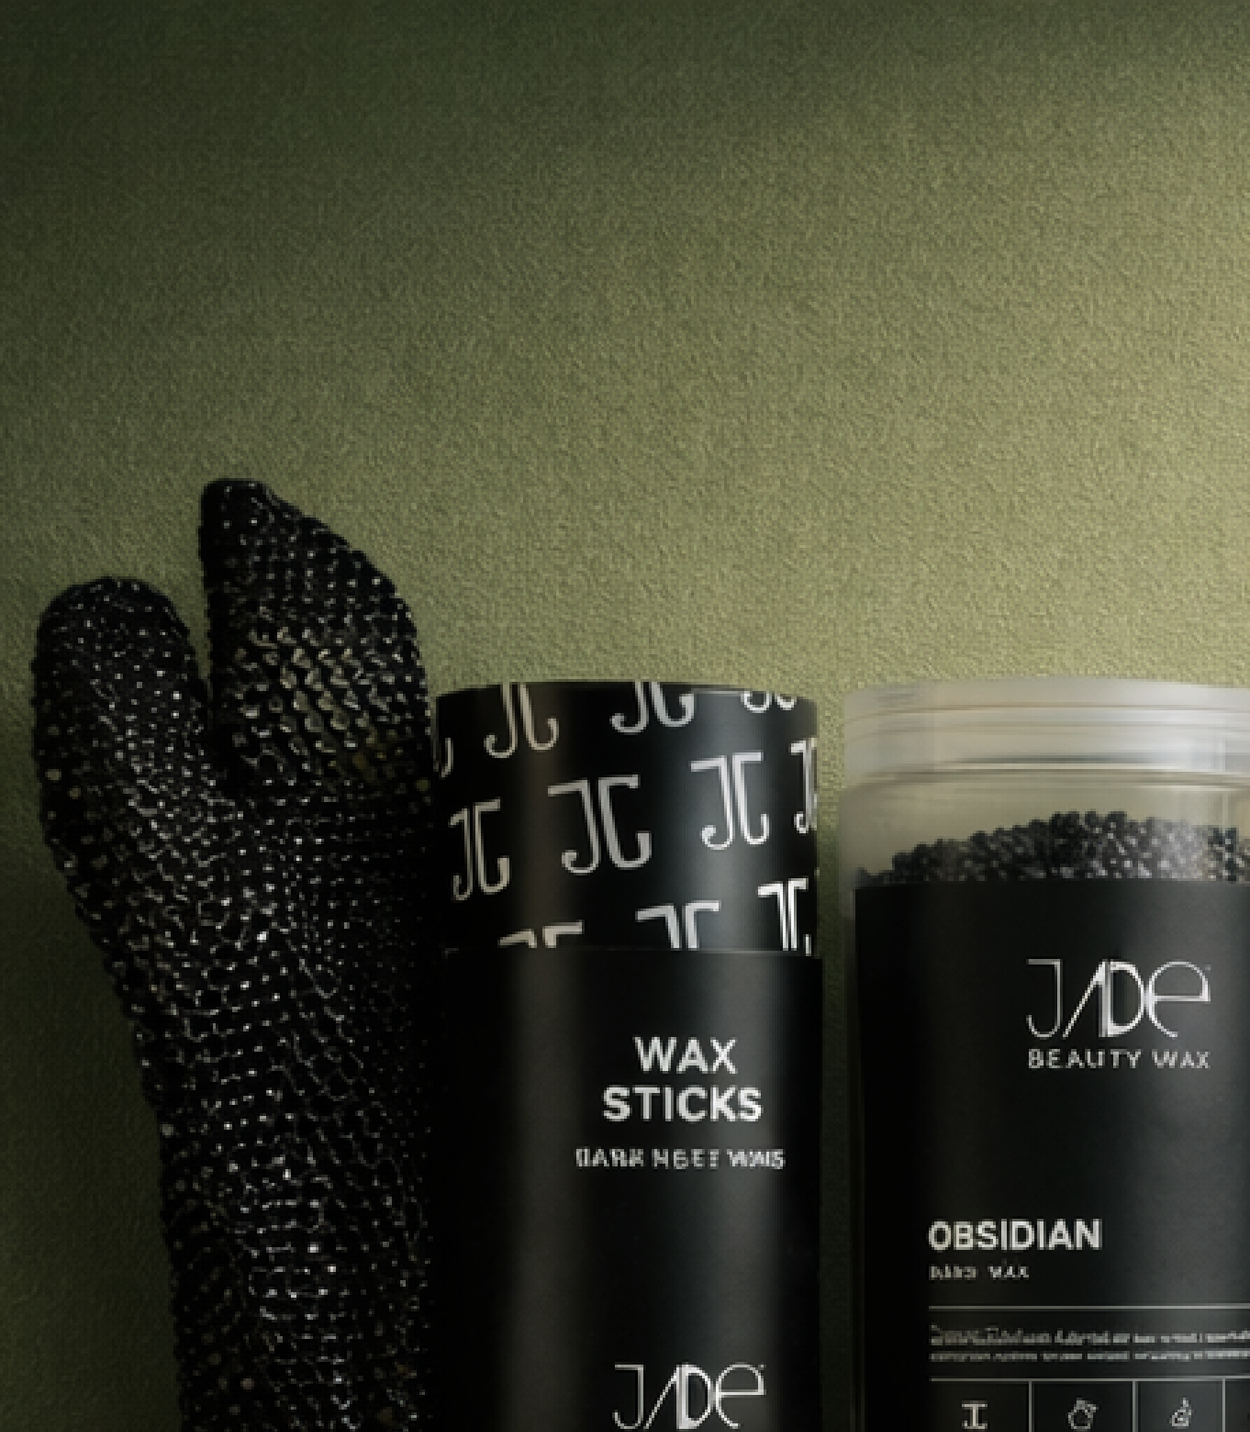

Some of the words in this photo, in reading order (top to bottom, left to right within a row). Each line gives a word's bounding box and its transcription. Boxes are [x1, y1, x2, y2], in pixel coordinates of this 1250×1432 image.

[634, 1036, 738, 1075] WAX
[1028, 1048, 1142, 1069] BEAUTY
[1151, 1050, 1211, 1069] WAX
[602, 1085, 763, 1123] STICKS
[928, 1218, 1102, 1251] OBSIDIAN
